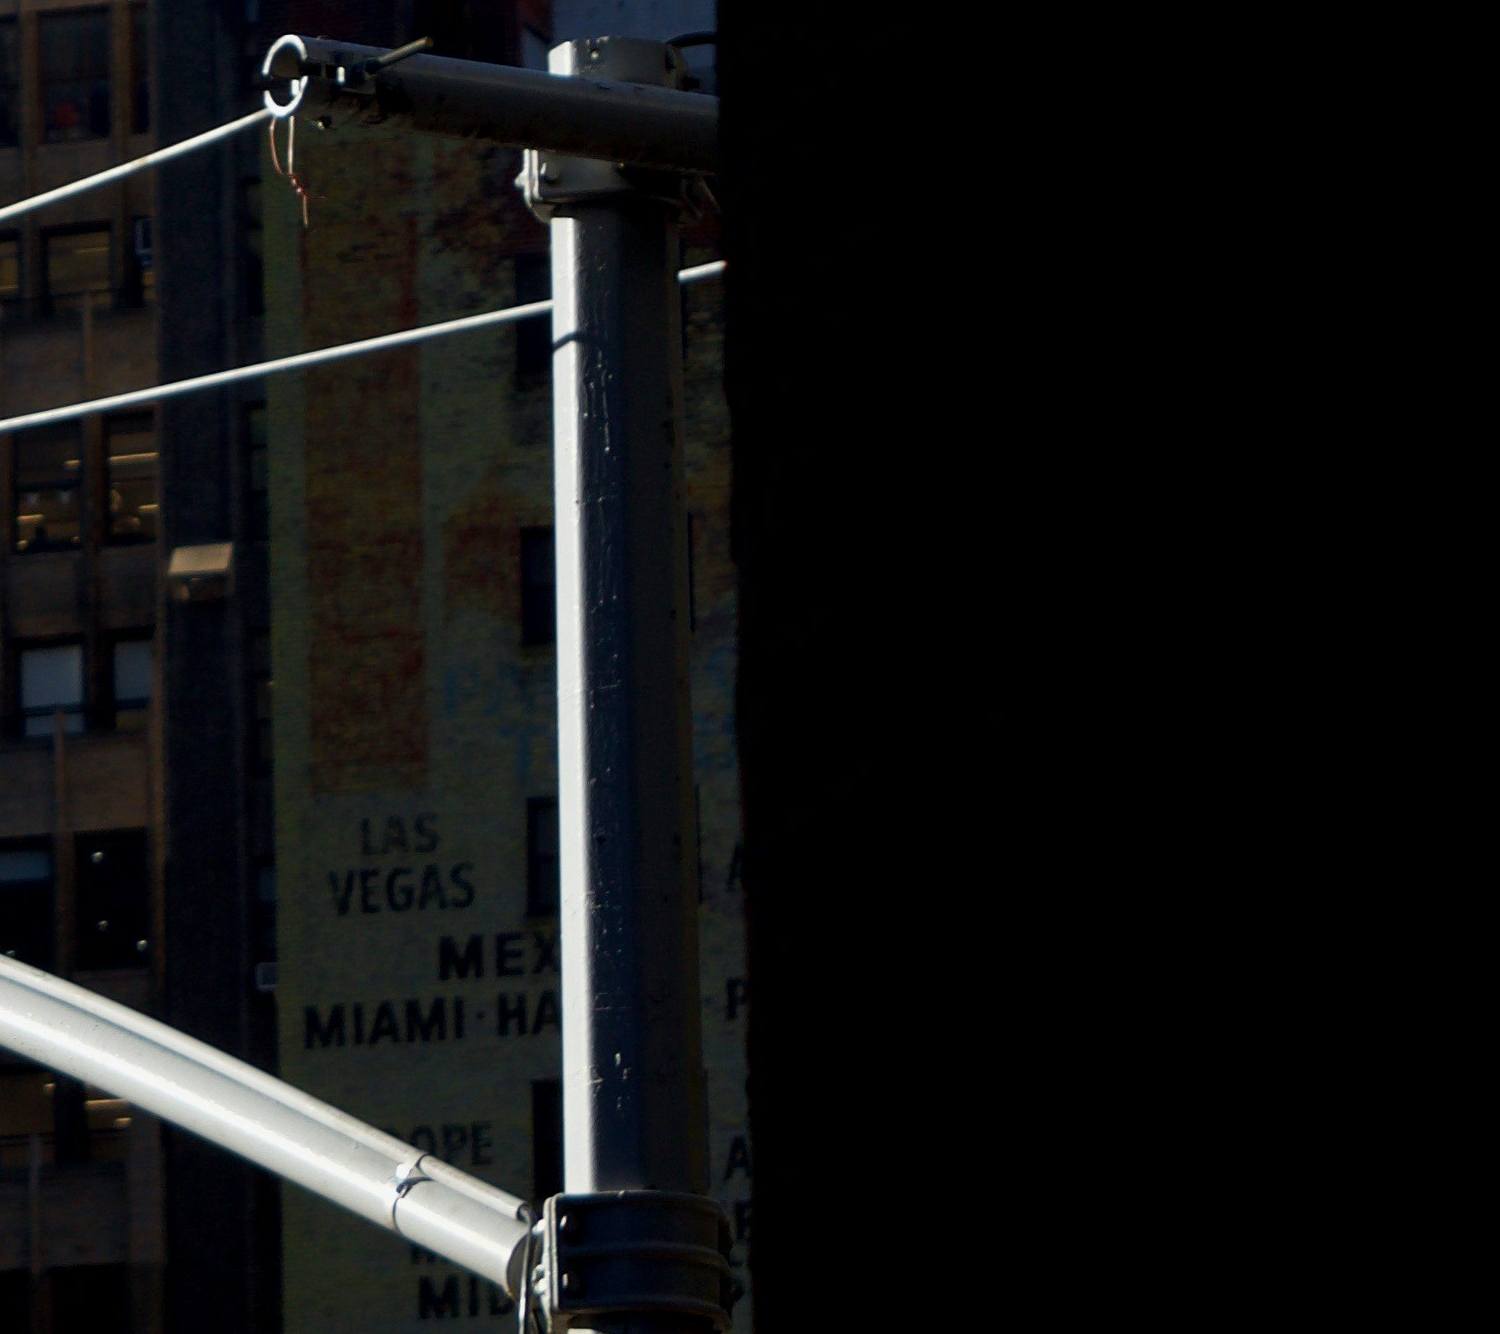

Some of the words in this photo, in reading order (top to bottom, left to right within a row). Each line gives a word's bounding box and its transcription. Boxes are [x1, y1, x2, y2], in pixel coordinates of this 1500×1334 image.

[360, 813, 439, 856] LAS
[329, 863, 475, 915] VEGAS
[304, 998, 465, 1049] MIAMI
[393, 1120, 493, 1166] OPE
